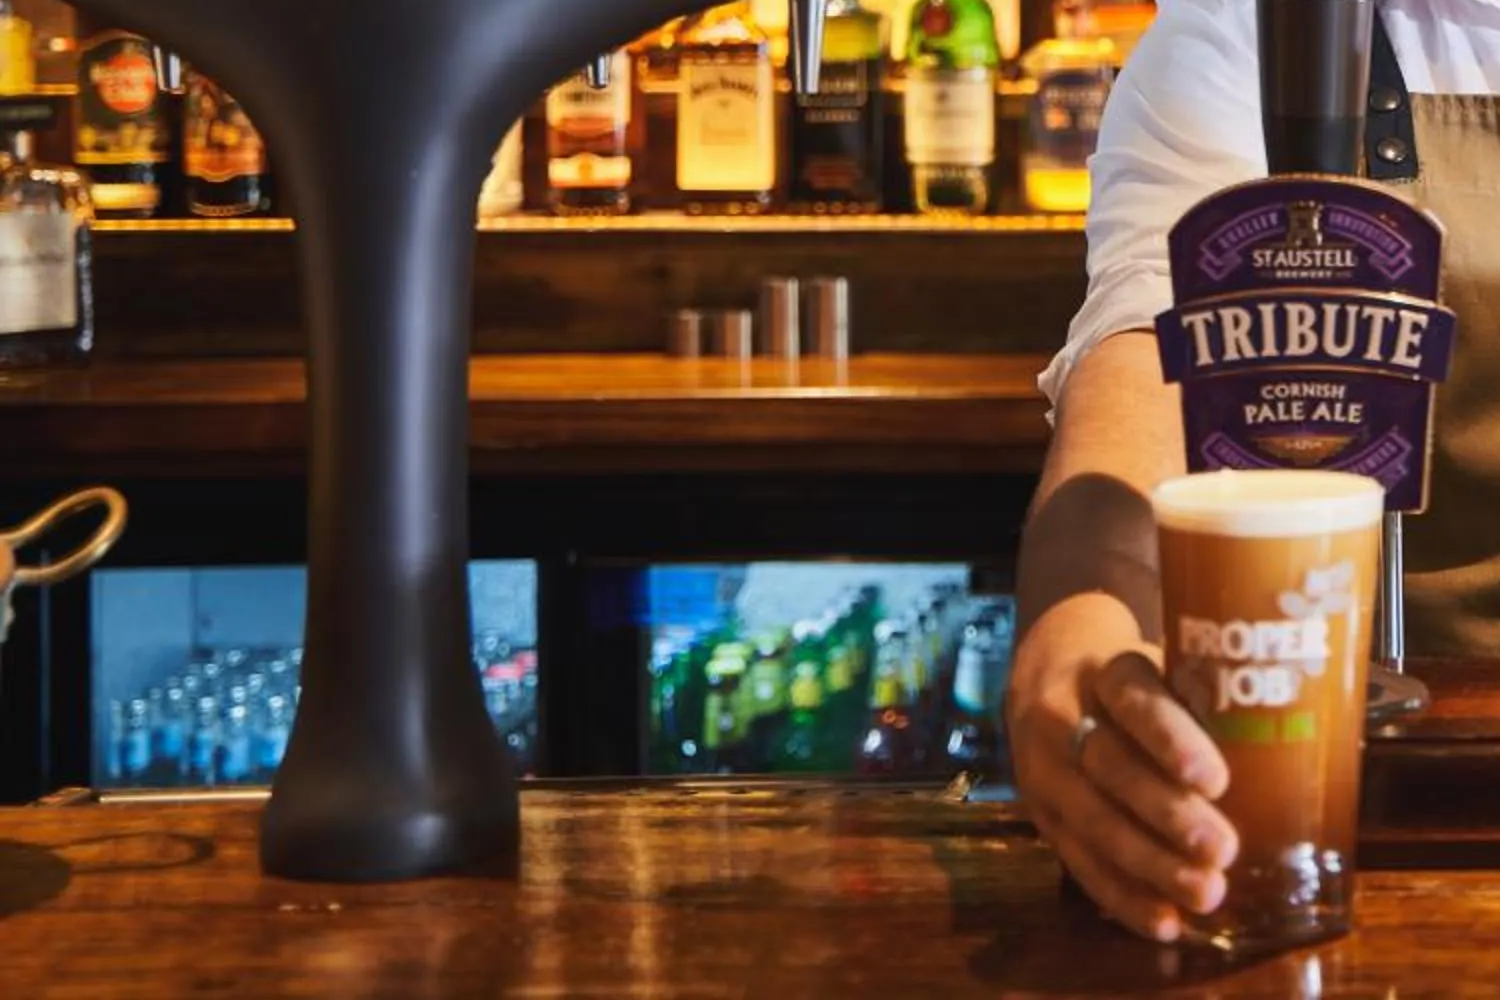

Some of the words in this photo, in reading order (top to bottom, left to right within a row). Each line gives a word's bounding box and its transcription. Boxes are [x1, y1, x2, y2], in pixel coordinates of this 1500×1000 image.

[1273, 248, 1355, 267] AUSTELL
[1181, 302, 1429, 369] TRIBUTE
[1261, 381, 1347, 400] CORNISH
[1244, 402, 1306, 425] PALE
[1312, 402, 1363, 424] ALE
